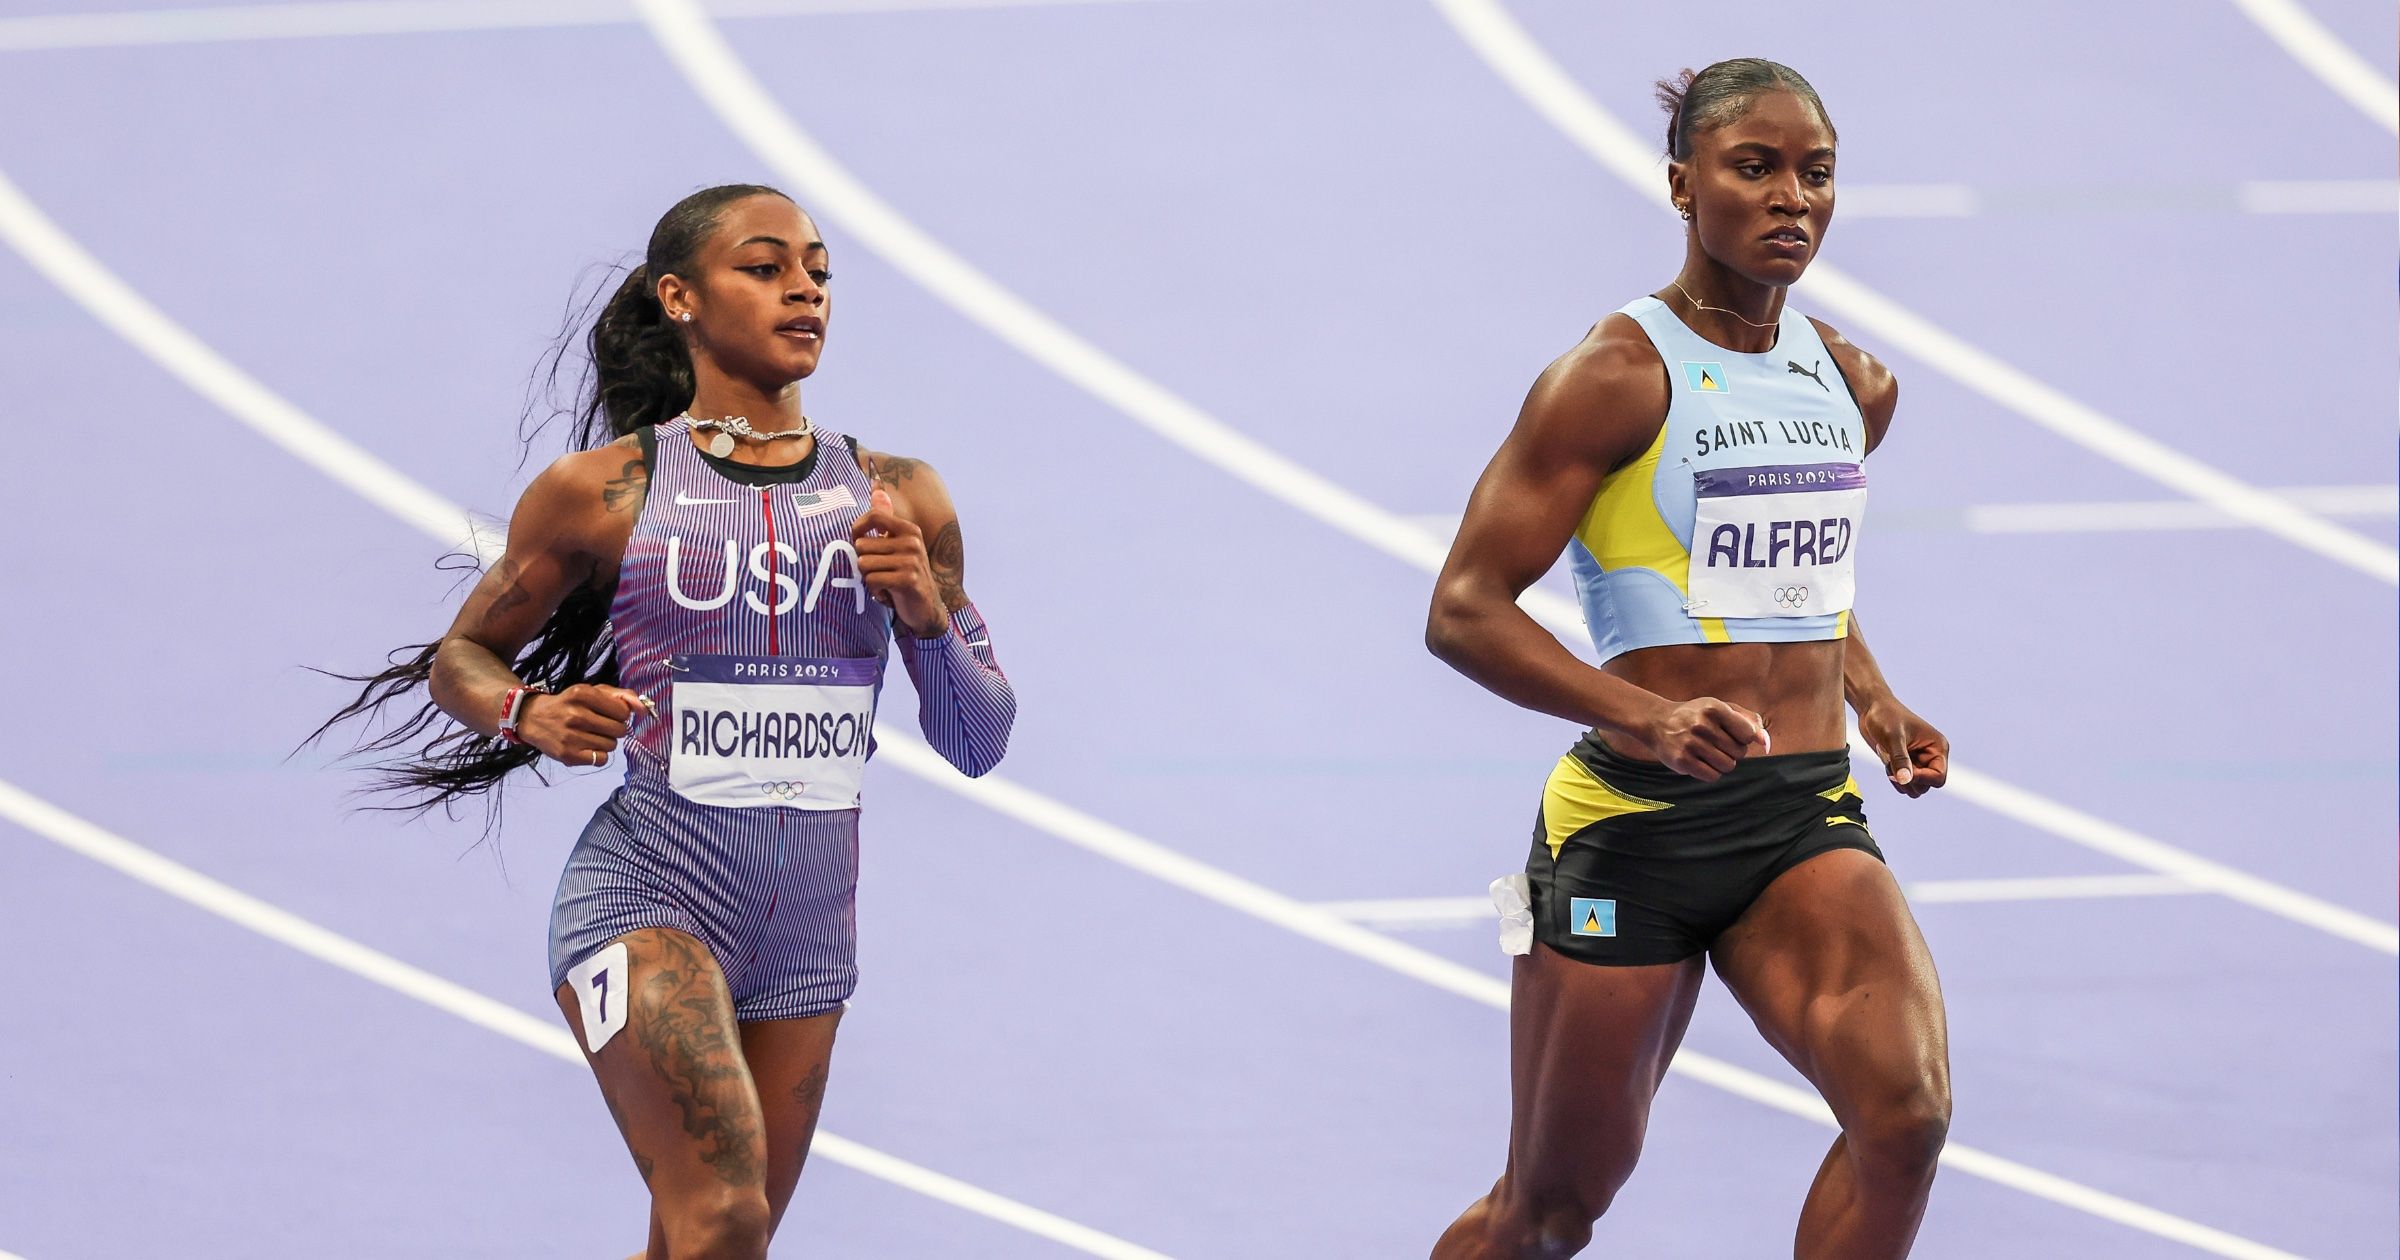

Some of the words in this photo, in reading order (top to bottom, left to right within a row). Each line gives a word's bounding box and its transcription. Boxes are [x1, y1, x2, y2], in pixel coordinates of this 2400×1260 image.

[1695, 421, 1768, 457] SAINT
[1779, 420, 1853, 454] LUCIA
[1795, 471, 1836, 485] 2024
[1706, 517, 1851, 568] ALFRED
[667, 536, 865, 616] USA
[794, 664, 840, 679] 2024
[681, 709, 870, 759] RICHARDSON
[591, 967, 609, 1024] 7
